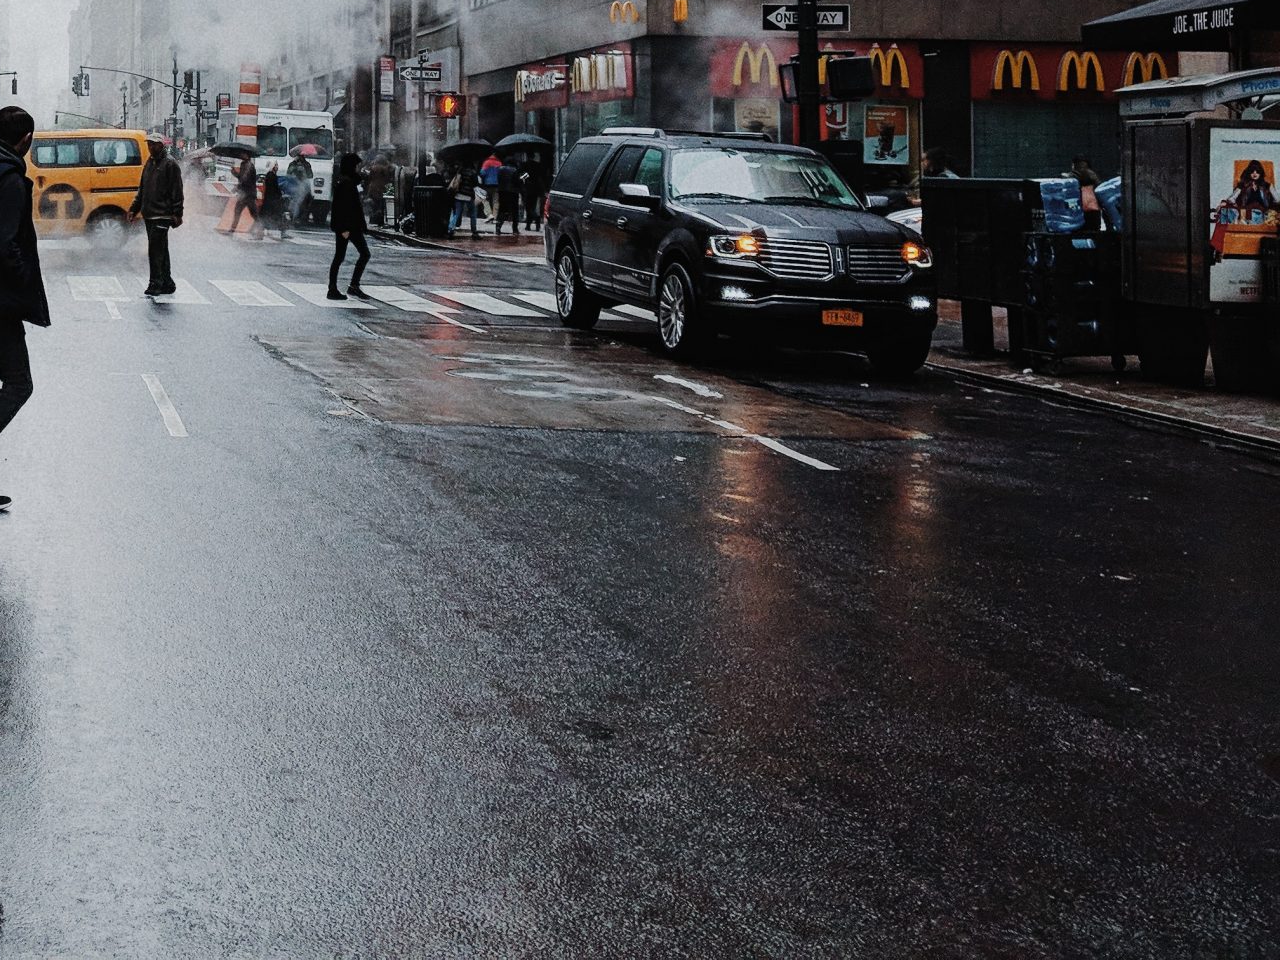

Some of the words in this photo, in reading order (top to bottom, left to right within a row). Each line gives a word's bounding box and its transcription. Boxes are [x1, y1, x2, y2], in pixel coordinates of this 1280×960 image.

[775, 12, 800, 23] ONE
[1173, 14, 1188, 34] JOE
[1193, 11, 1208, 31] THE
[1210, 7, 1234, 29] JUICE
